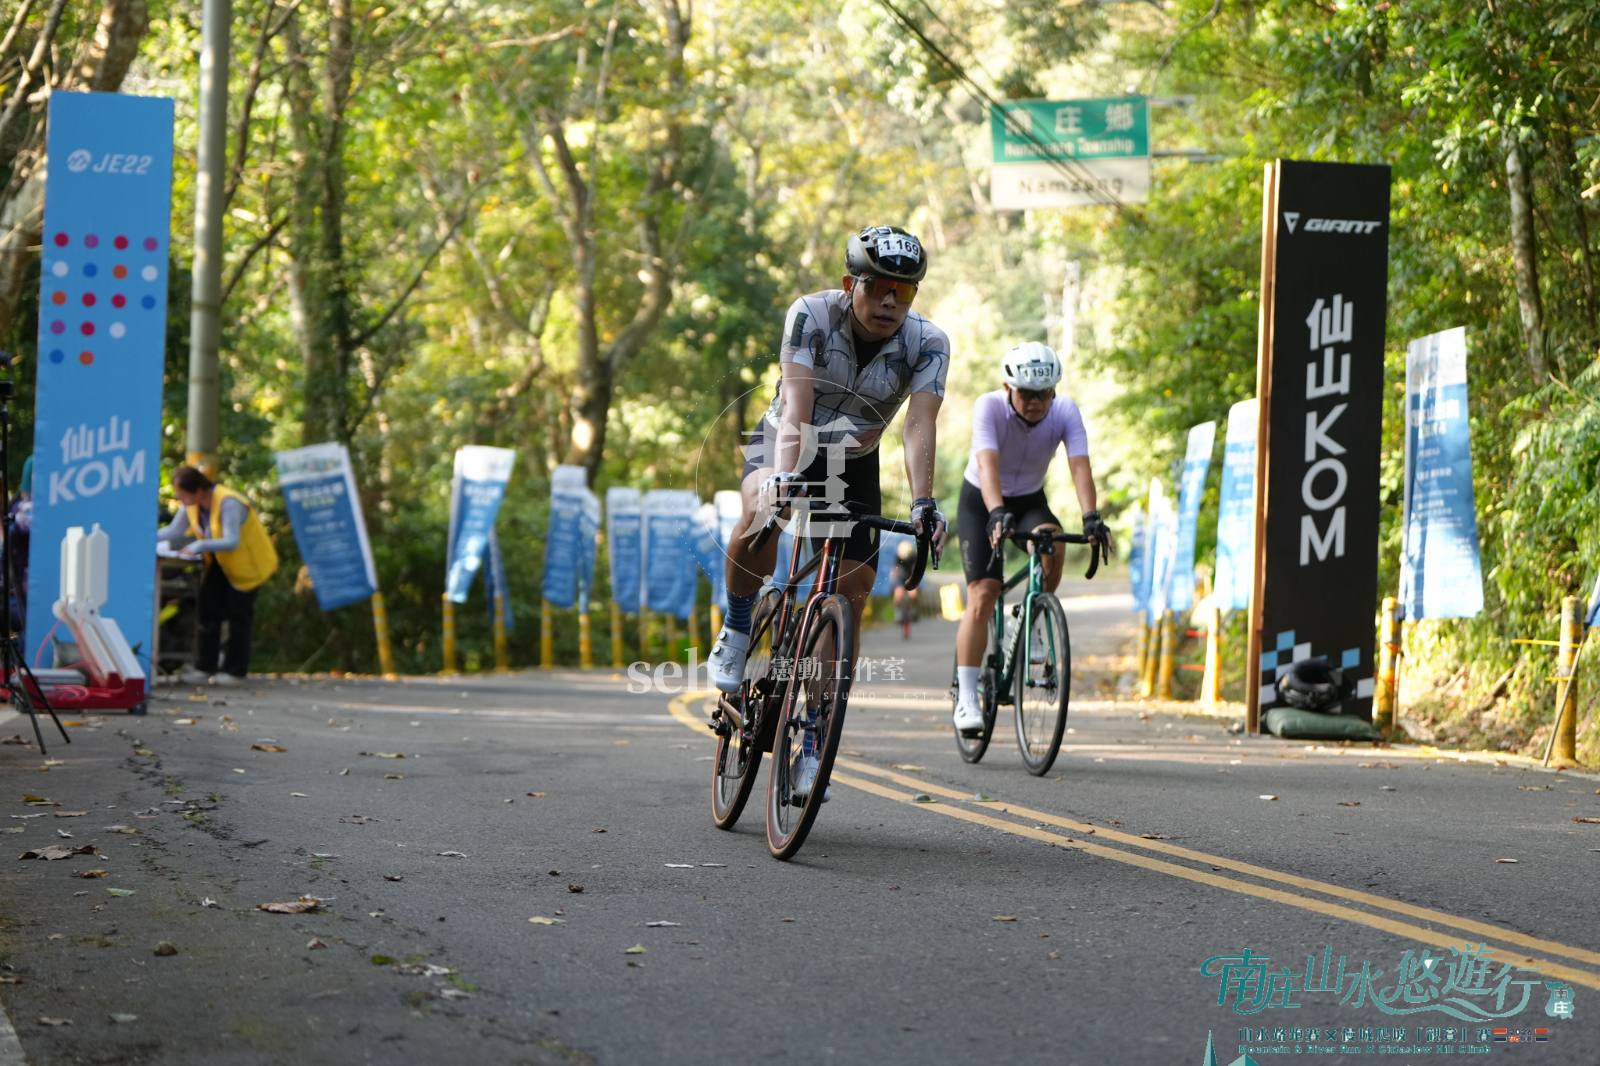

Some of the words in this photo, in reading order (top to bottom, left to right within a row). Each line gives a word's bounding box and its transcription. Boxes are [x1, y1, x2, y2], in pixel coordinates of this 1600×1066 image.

[93, 153, 153, 176] JE22
[1303, 218, 1382, 235] GIANT
[1304, 293, 1355, 400] 仙山
[60, 415, 132, 464] 仙山
[48, 449, 146, 506] KOM
[1299, 403, 1348, 566] KOM
